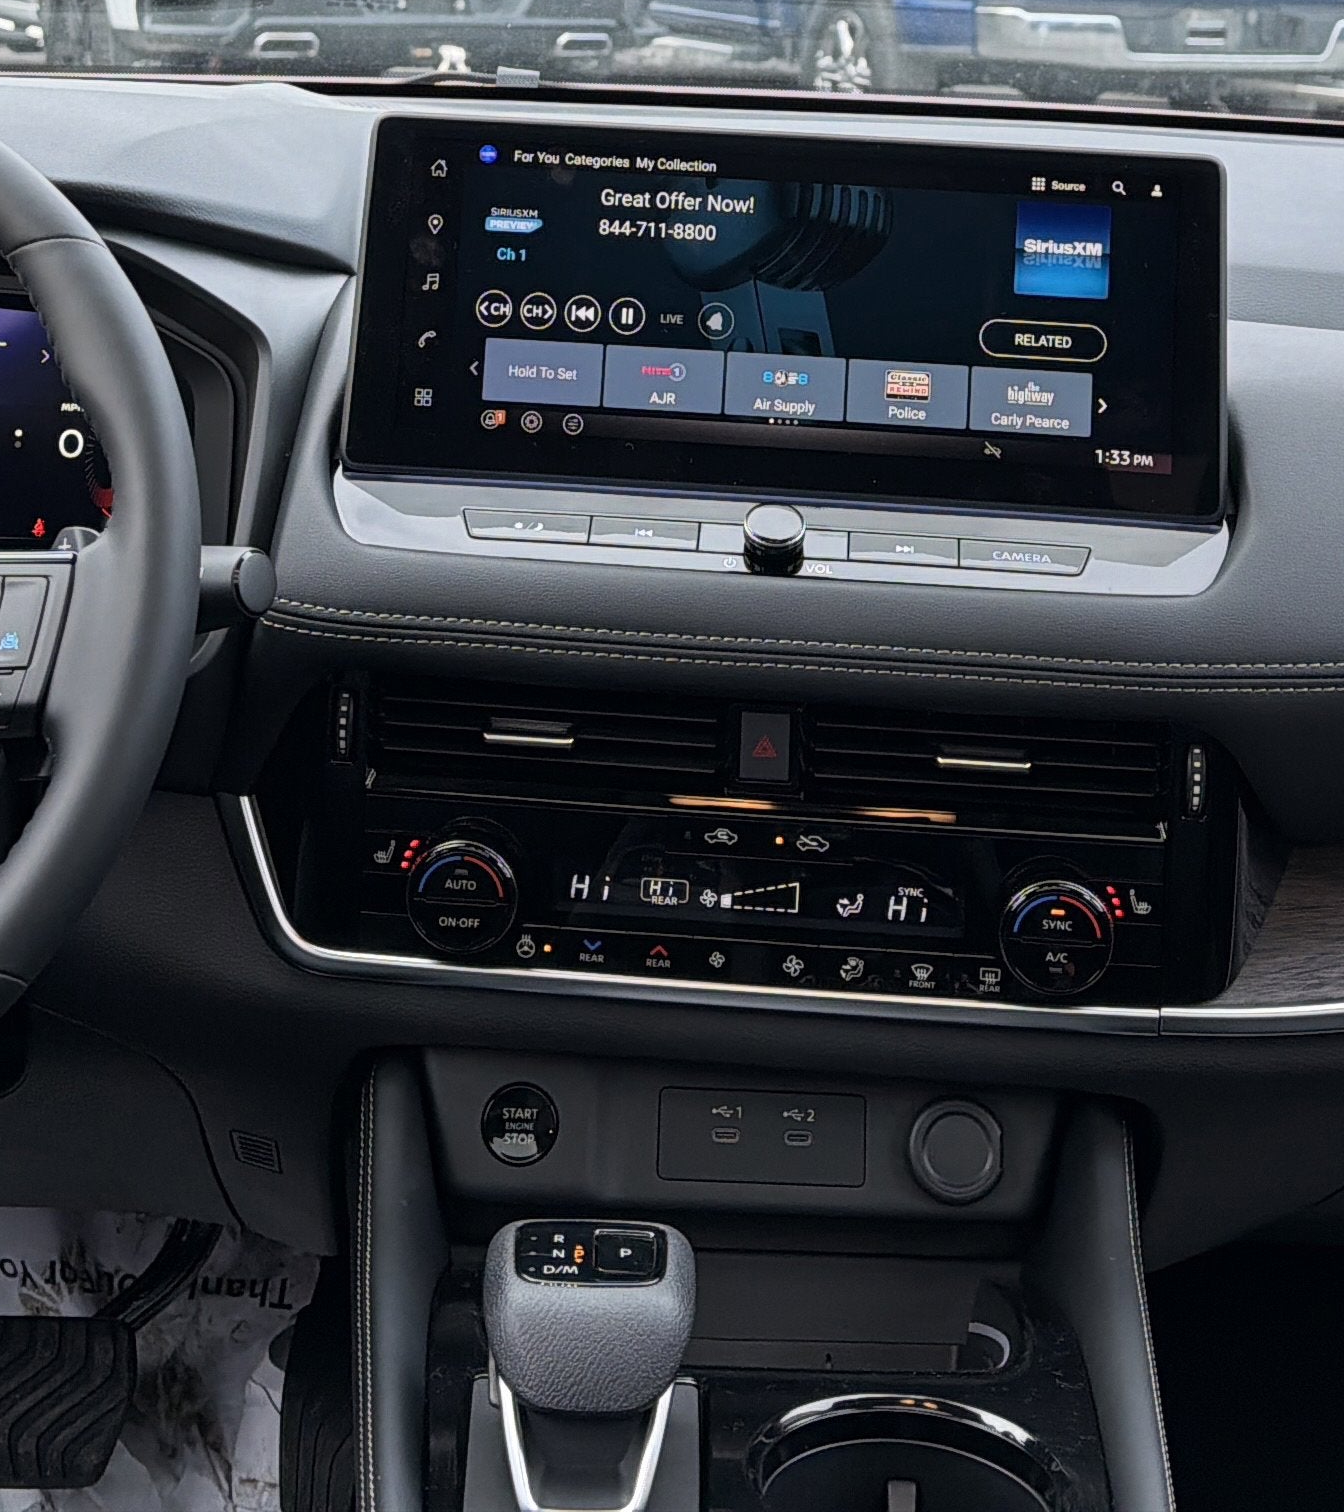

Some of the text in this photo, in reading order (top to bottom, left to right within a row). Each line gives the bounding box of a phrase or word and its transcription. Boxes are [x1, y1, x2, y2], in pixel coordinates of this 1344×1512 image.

[513, 149, 535, 165] For
[536, 150, 561, 166] You
[564, 151, 631, 171] Categories
[635, 155, 656, 173] My
[656, 157, 718, 174] Collection
[1050, 179, 1087, 193] Source
[600, 187, 756, 215] Great Offer Now!
[489, 206, 539, 220] SIRIUSXM
[598, 218, 718, 242] 844-711-8800
[1023, 238, 1104, 257] SiriusXM
[495, 247, 527, 263] Ch 1
[489, 301, 512, 316] CH
[522, 304, 545, 319] CH
[659, 312, 685, 326] LIVE
[1013, 332, 1074, 350] RELATED
[507, 364, 578, 381] Hold To Set
[888, 371, 929, 384] Classic
[888, 384, 929, 396] REWIND
[1026, 380, 1041, 392] the
[648, 390, 677, 406] AJR
[1006, 383, 1056, 407] highway
[752, 397, 817, 417] Air Supply
[887, 405, 927, 422] Police
[990, 411, 1071, 431] Carly Pearce
[58, 427, 85, 459] 0
[1094, 448, 1155, 468] 1:33 PM
[991, 549, 1053, 566] CAMERA
[804, 563, 834, 576] VOL
[443, 877, 478, 892] AUTO
[897, 886, 925, 899] SYNC
[650, 895, 679, 907] REAR
[1041, 918, 1074, 932] SYNC
[578, 952, 606, 964] REAR
[645, 957, 672, 969] REAR
[1044, 951, 1069, 965] A/C
[908, 979, 937, 990] FRONT
[978, 983, 1002, 994] REAR
[501, 1106, 540, 1121] START
[734, 1105, 743, 1120] 1
[805, 1109, 816, 1123] 2
[504, 1121, 536, 1132] ENGINE
[502, 1132, 537, 1146] STOP
[552, 1233, 566, 1244] R
[551, 1248, 566, 1259] N
[619, 1247, 633, 1259] P
[542, 1264, 579, 1276] D/M
